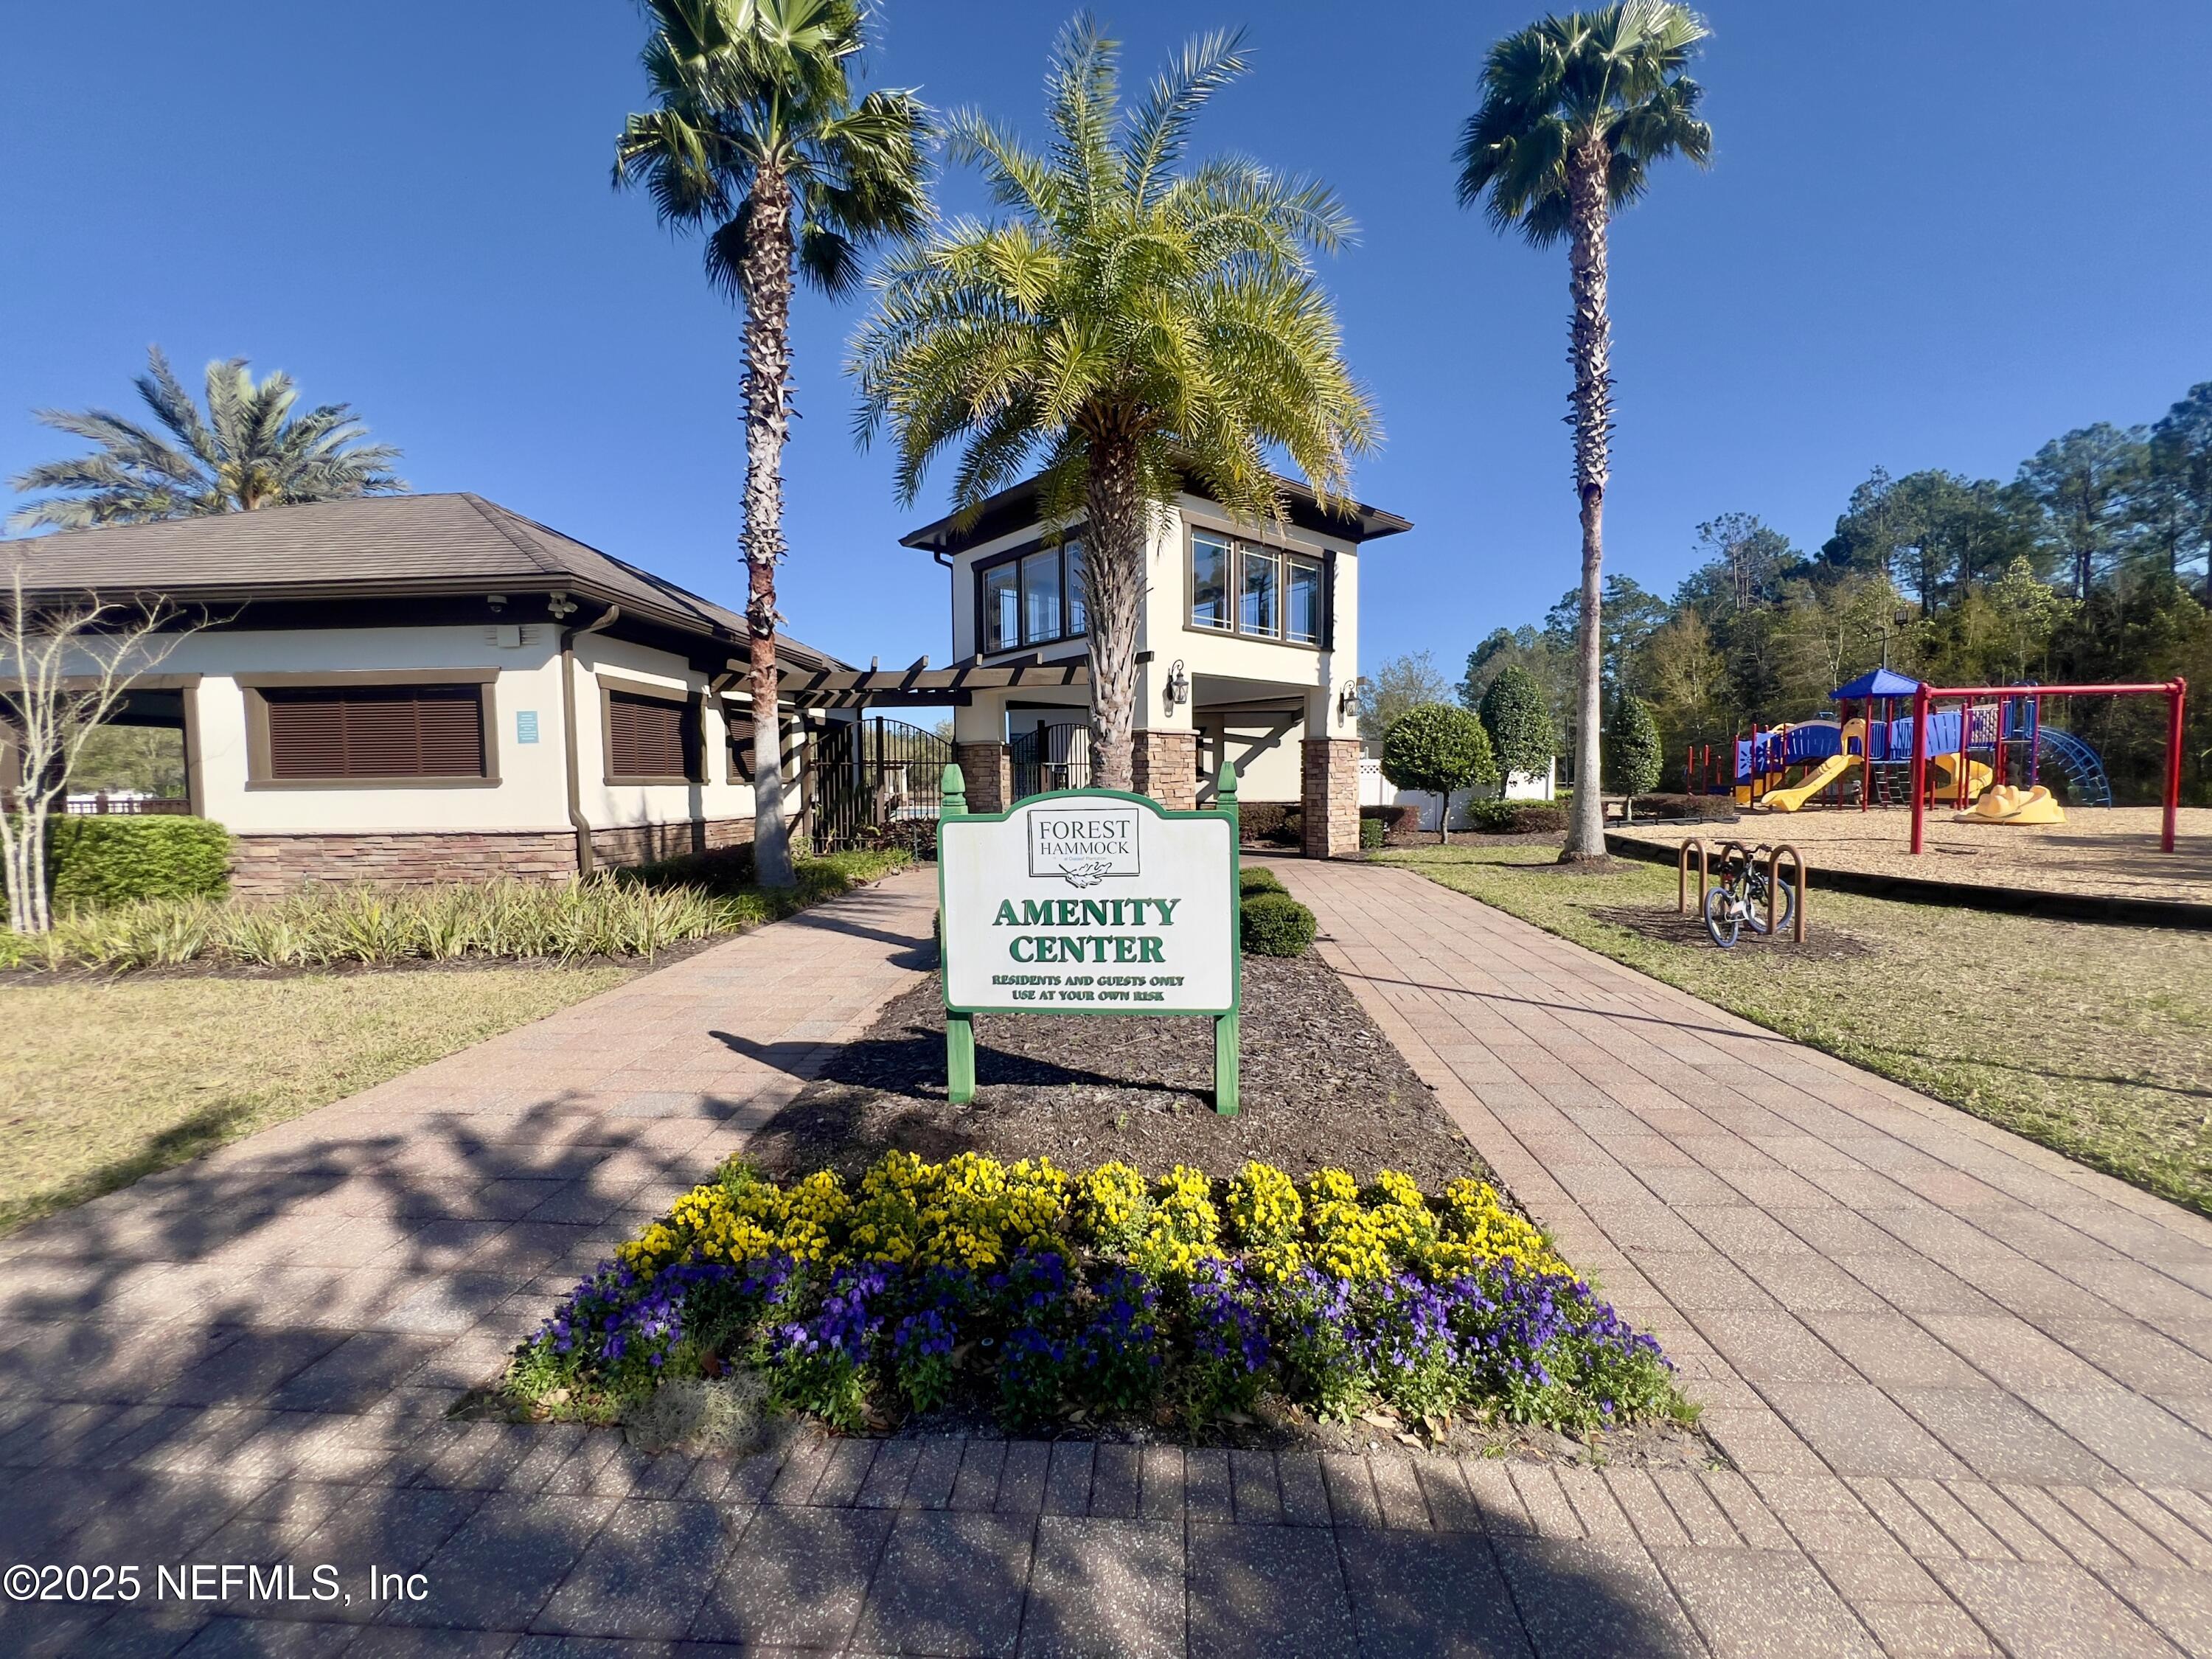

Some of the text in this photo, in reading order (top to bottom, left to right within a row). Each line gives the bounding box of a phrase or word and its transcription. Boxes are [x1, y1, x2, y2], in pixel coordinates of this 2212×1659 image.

[1039, 820, 1130, 839] FOREST
[1040, 841, 1130, 855] HAMMOCK
[992, 899, 1181, 926] AMENITY
[1009, 936, 1166, 963] CENTER
[992, 975, 1185, 987] RESIDENTS AND GUESTS ONLY
[1012, 990, 1165, 1001] USE AT YOUR OWN RISK
